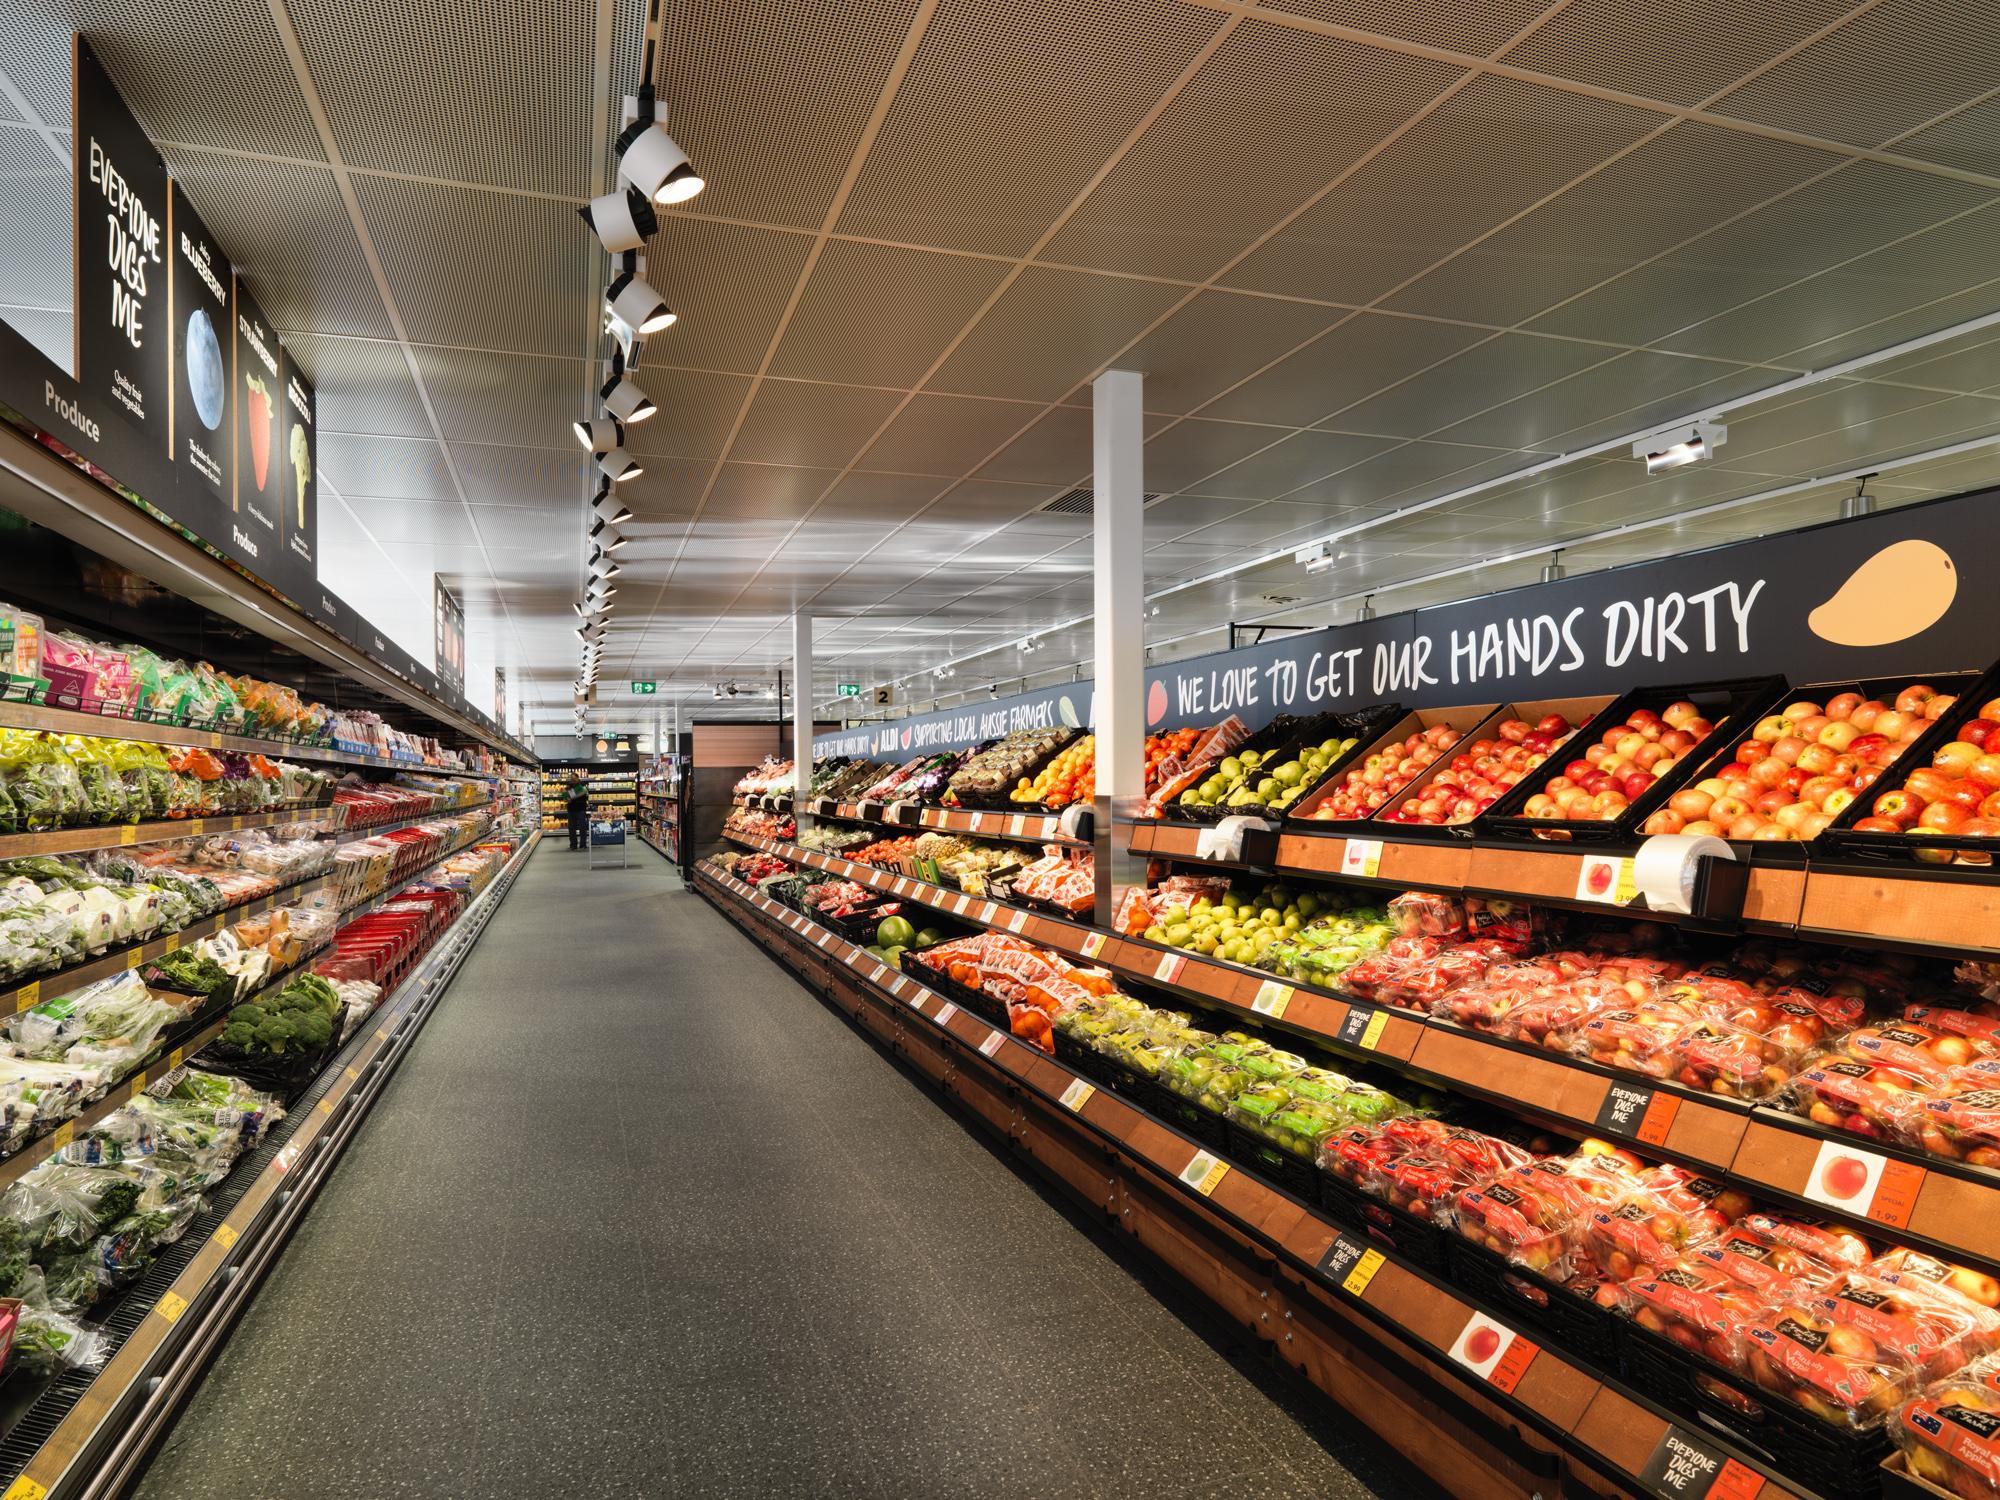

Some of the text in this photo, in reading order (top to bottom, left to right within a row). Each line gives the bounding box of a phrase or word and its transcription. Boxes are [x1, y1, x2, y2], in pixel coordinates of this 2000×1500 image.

[90, 136, 161, 263] EVERYONE
[107, 214, 147, 296] DIGS
[181, 231, 226, 307] BLUEBERRY
[112, 279, 143, 348] ME
[239, 314, 278, 378] STRAWBERRY
[114, 369, 142, 403] Quality fruit
[45, 379, 100, 442] Produce
[111, 386, 145, 419] and vegetables
[233, 524, 258, 558] Produce
[1178, 579, 1766, 716] WE LOVE TO GET OUR HANDS DIRTY
[878, 690, 889, 703] 2
[914, 719, 953, 749] SUPPORTING
[953, 714, 978, 742] LOCAL
[979, 709, 1008, 740] AUSSIE
[1009, 699, 1054, 734] FARMERS
[880, 727, 899, 753] ALDI
[1349, 1009, 1370, 1022] EVERYONE
[1349, 1017, 1364, 1028] DIGS
[1346, 1026, 1358, 1036] ME
[1611, 1087, 1648, 1105] EVERYONE
[1614, 1098, 1636, 1113] DIGS
[1611, 1110, 1629, 1123] ME
[1333, 1249, 1351, 1264] DIGS
[1335, 1239, 1362, 1259] EVERYONE
[1328, 1259, 1344, 1272] ME
[1666, 1437, 1718, 1473] EVERYONE
[1959, 1443, 1992, 1470] Apples
[1962, 1436, 1992, 1458] Royal
[1662, 1469, 1688, 1490] ME
[1669, 1454, 1700, 1479] DIGS
